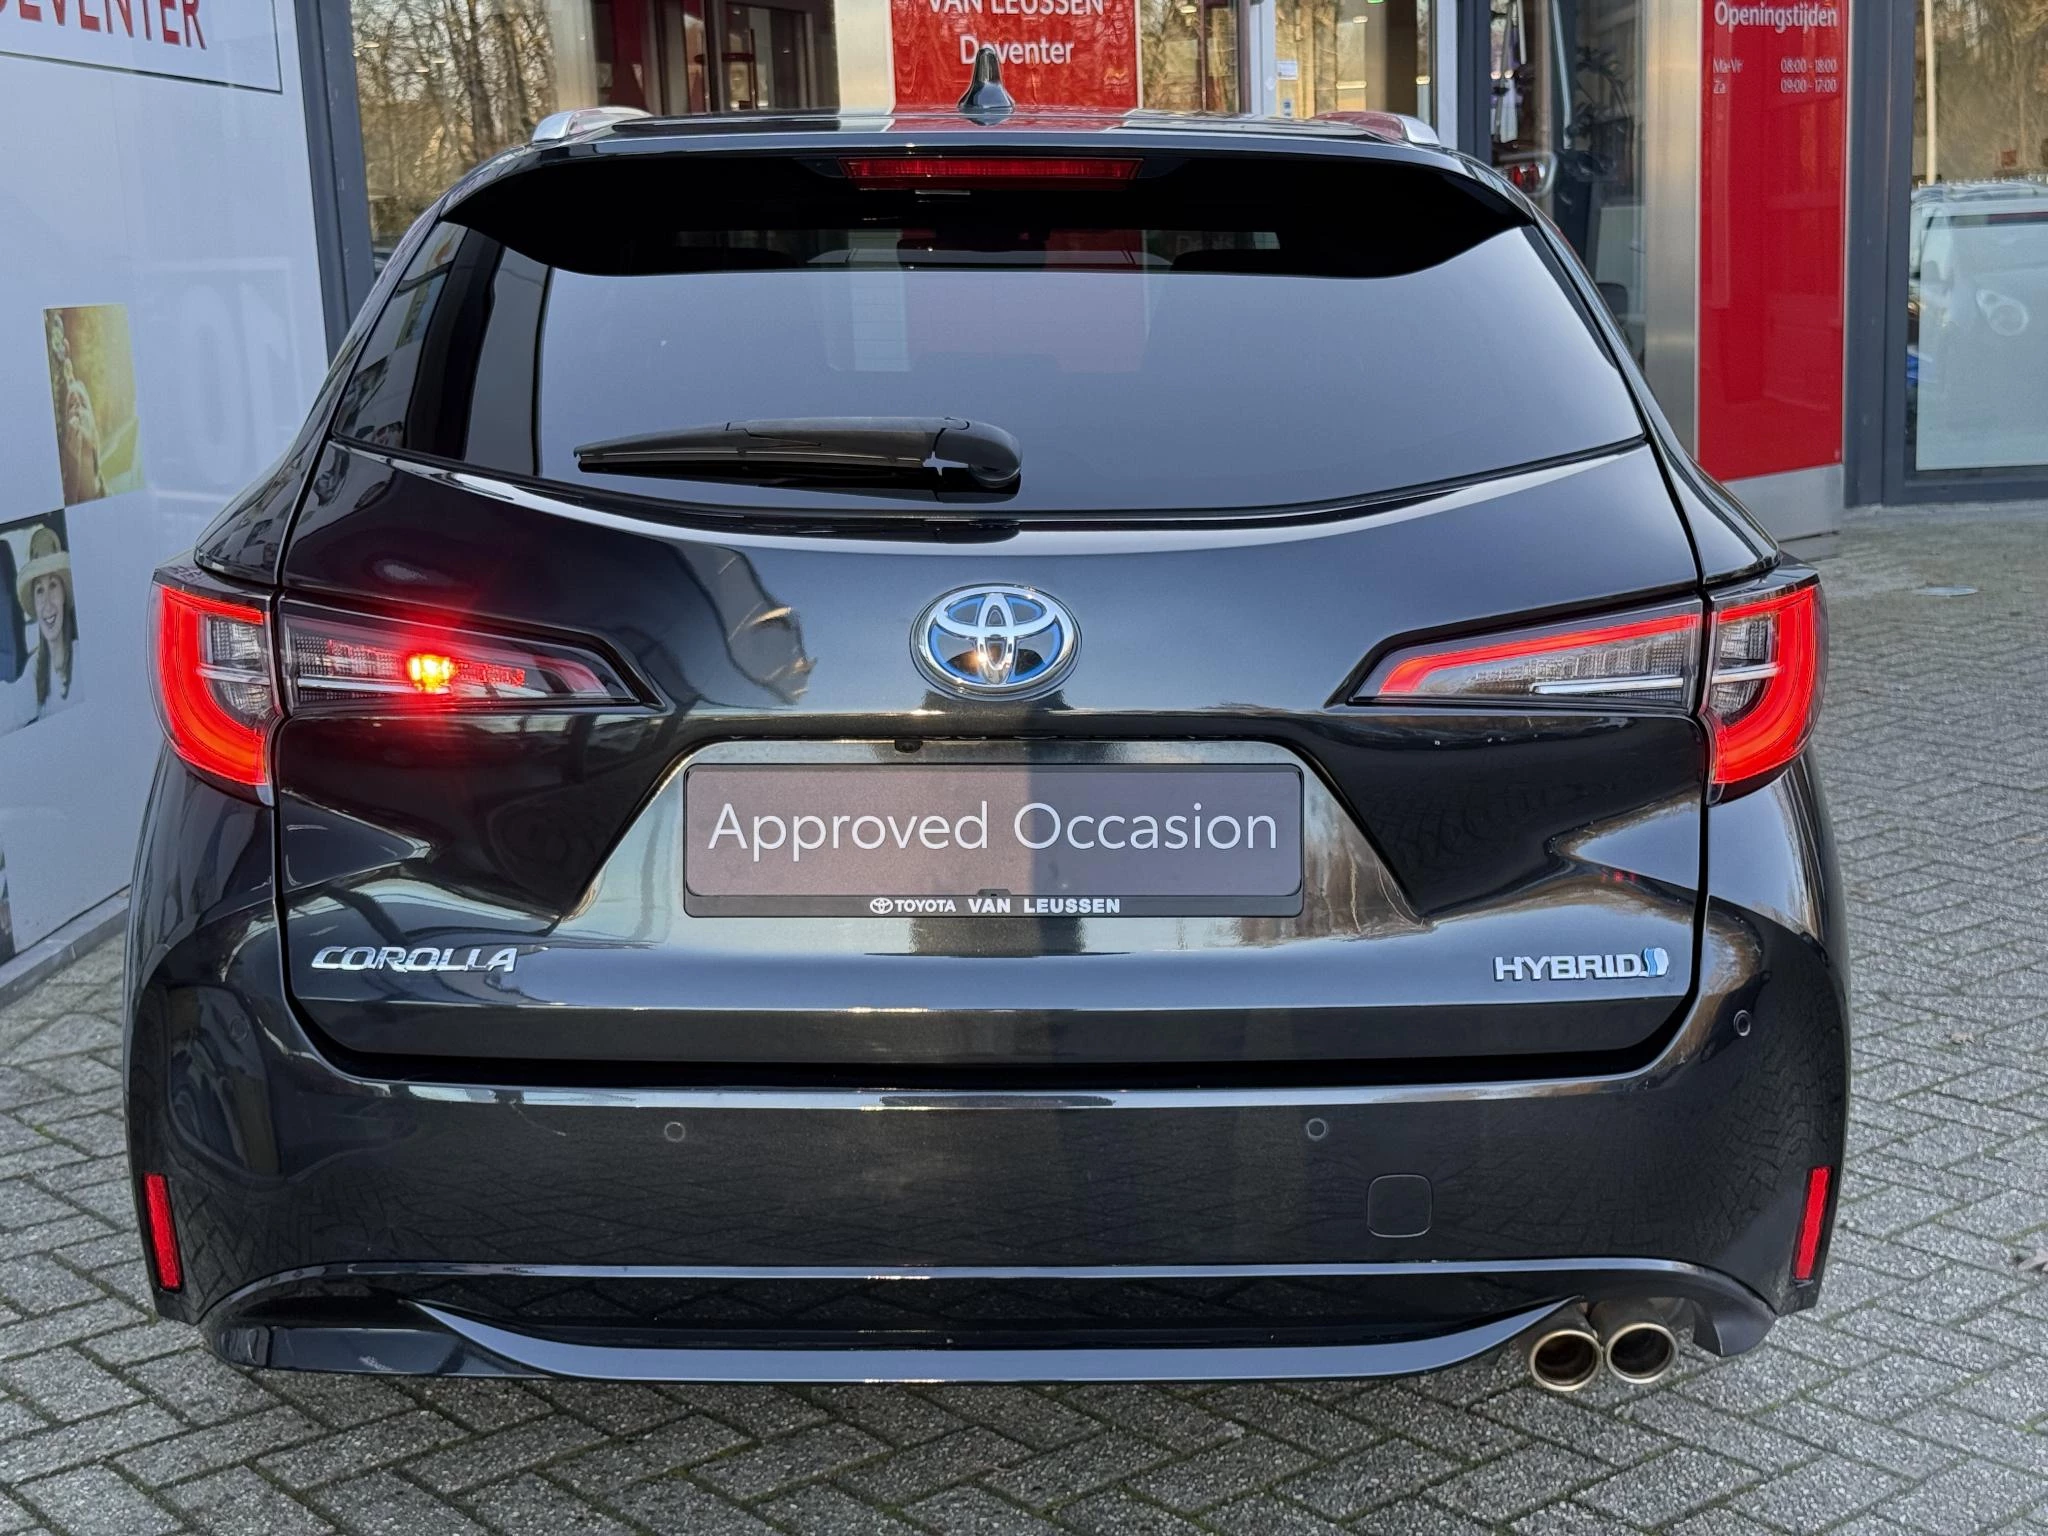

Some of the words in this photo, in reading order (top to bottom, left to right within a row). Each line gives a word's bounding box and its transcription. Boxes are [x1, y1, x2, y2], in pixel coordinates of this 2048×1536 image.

[1714, 1, 1838, 33] Openingstijden
[960, 34, 1075, 65] Dventer
[707, 800, 989, 862] Approved
[1013, 802, 1278, 850] Occasion
[894, 899, 957, 914] TOYOTA
[967, 898, 1011, 914] VAN
[1023, 898, 1121, 914] LEUSSEN
[311, 946, 518, 973] COROLLA
[1494, 953, 1645, 980] HYBRID
